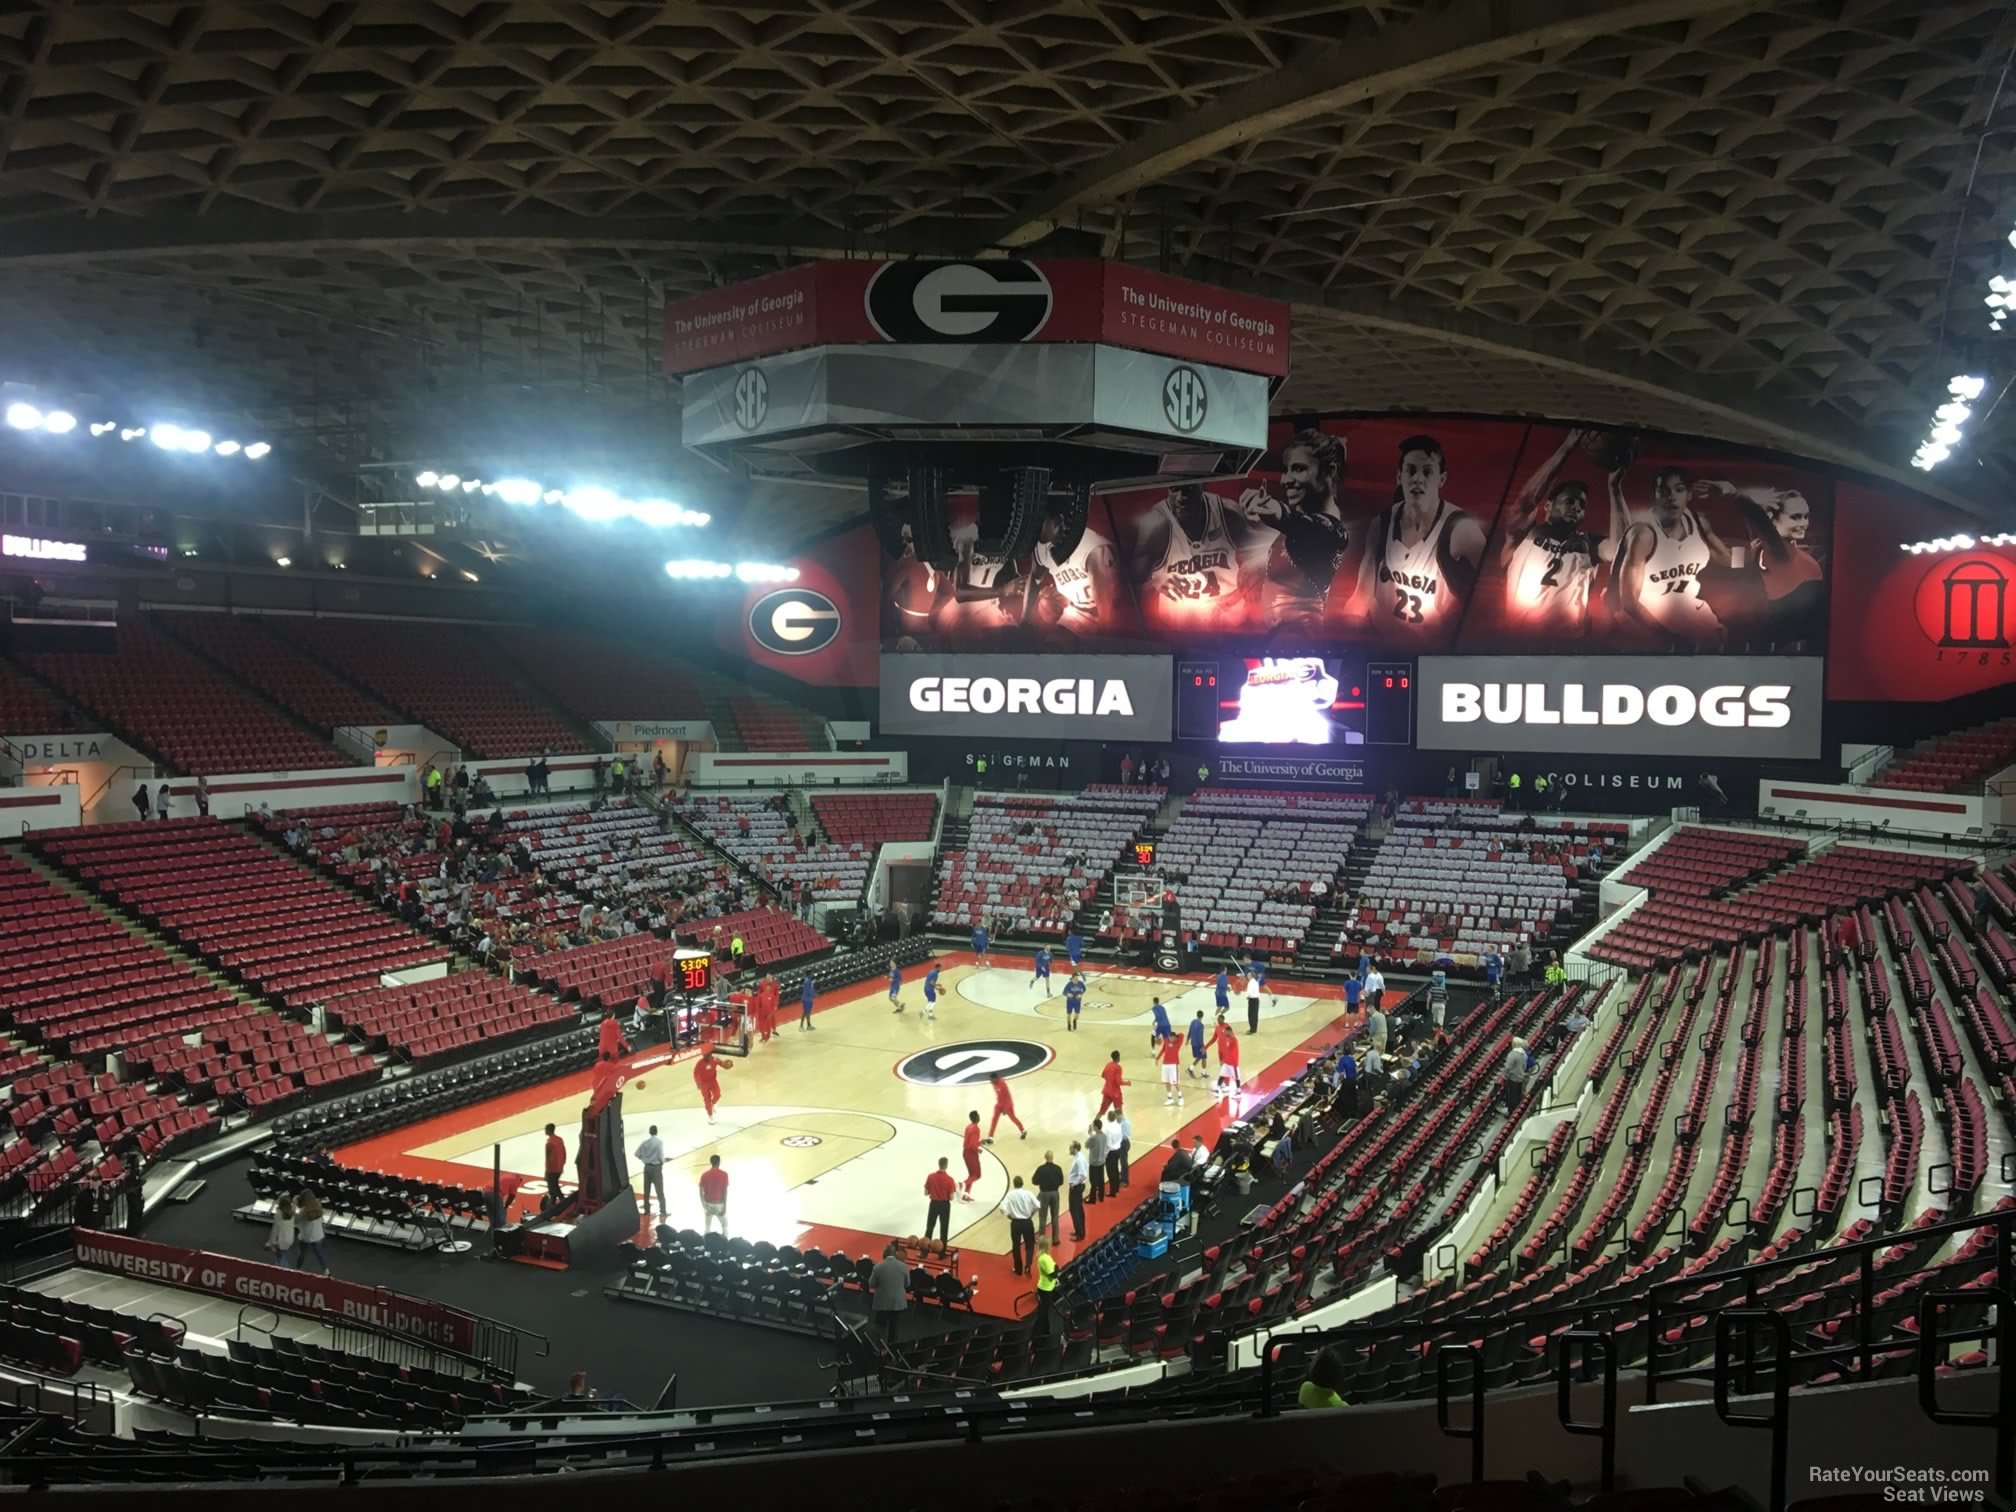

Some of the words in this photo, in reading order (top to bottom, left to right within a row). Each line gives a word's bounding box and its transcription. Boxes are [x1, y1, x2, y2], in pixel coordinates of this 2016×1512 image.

[675, 319, 692, 335] The
[694, 304, 745, 329] University
[749, 299, 758, 315] of
[761, 289, 804, 313] Georgia
[1121, 286, 1145, 306] The
[1149, 293, 1212, 325] University
[1215, 309, 1227, 324] of
[1230, 312, 1275, 337] Georgia
[675, 330, 734, 354] STEGEMAN
[742, 312, 804, 338] COLISEUM
[1121, 311, 1198, 339] STEGEMAN
[1206, 330, 1275, 355] COLISEUM
[735, 369, 768, 429] SEC
[1166, 369, 1205, 430] SEC
[981, 568, 991, 585] 1
[1540, 558, 1563, 587] 2
[1650, 562, 1702, 583] GEORGI
[1393, 588, 1424, 623] 23
[1936, 650, 2011, 666] 1785
[909, 676, 1134, 716] GEORGIA
[1442, 682, 1791, 728] BULLDOGS
[634, 724, 687, 736] Piedmont
[24, 742, 101, 759] DELTA
[966, 753, 1070, 768] SGEMAN
[1219, 760, 1242, 774] The
[1243, 760, 1300, 779] University
[1301, 763, 1315, 776] of
[1315, 763, 1363, 781] Georgia
[1548, 772, 1683, 790] COLISEUM
[1138, 852, 1151, 864] 30
[680, 958, 708, 972] 53:09
[685, 970, 705, 989] 30
[77, 1244, 194, 1283] UNIVERSITY
[201, 1269, 228, 1288] OF
[236, 1276, 327, 1310] GEORGIA
[343, 1299, 455, 1344] BULLDOGS
